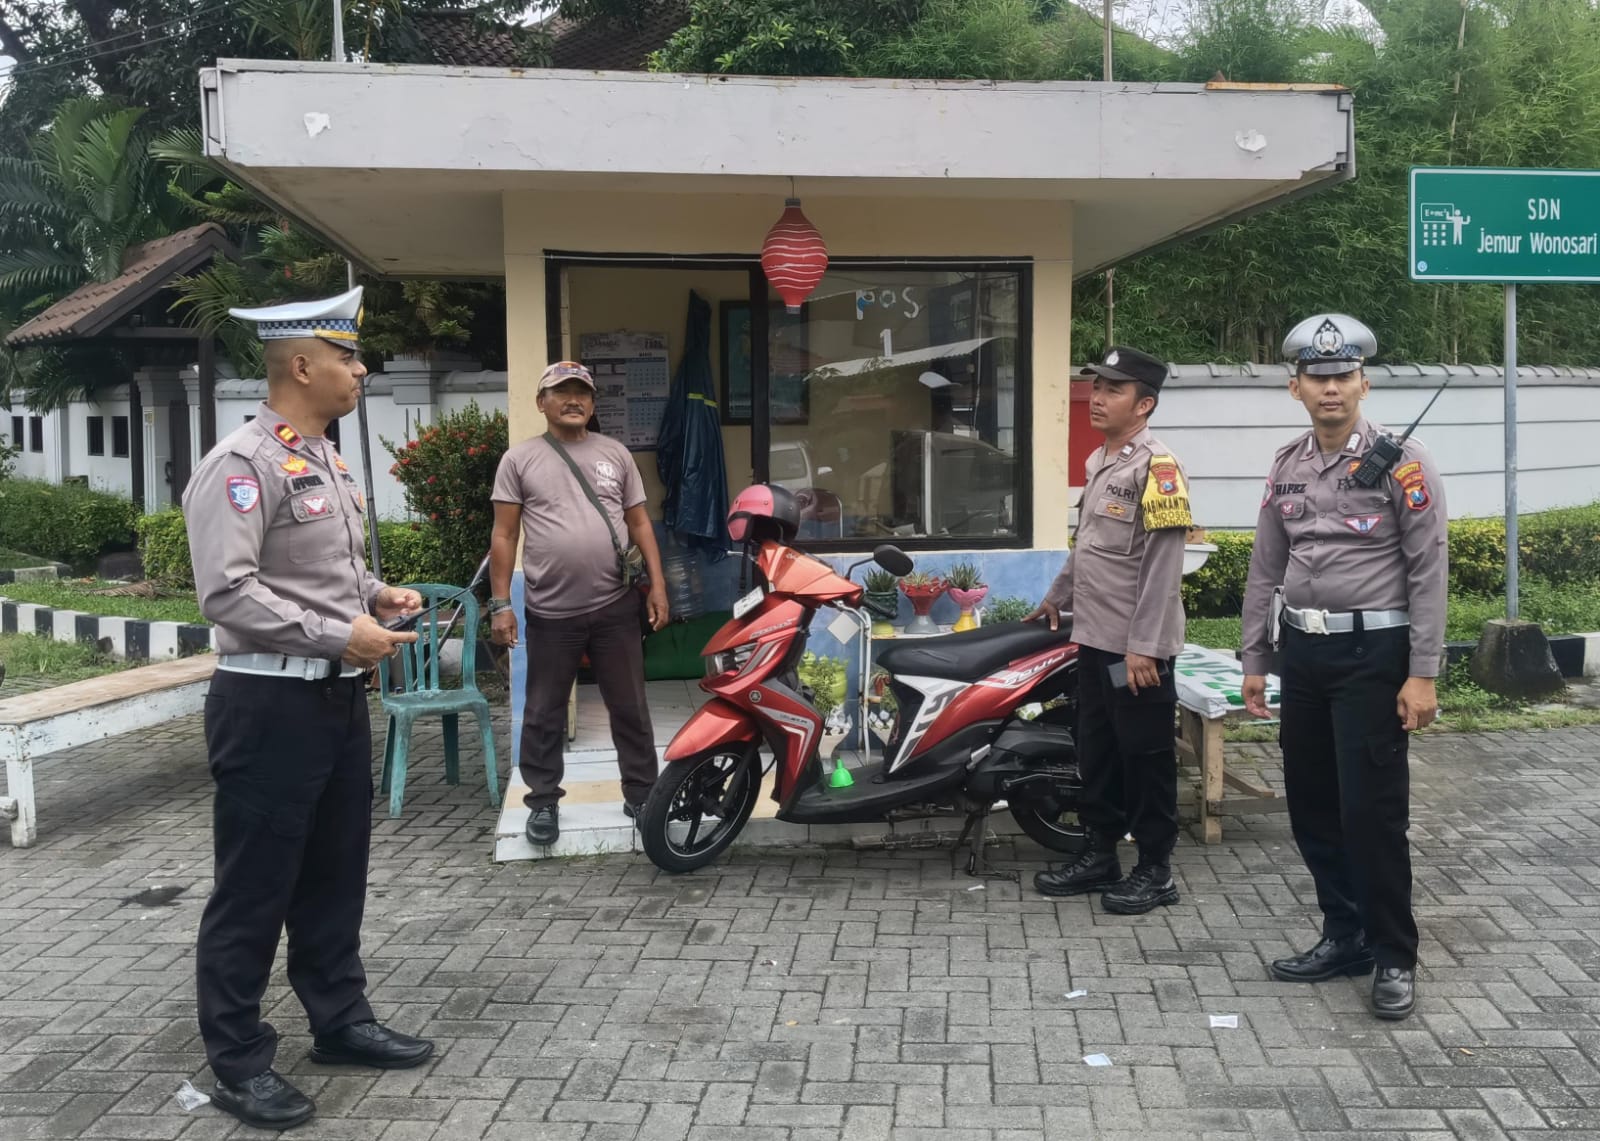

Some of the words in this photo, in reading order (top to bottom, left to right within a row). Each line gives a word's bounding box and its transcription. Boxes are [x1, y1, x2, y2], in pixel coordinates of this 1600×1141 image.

[1528, 199, 1561, 221] SDN
[1530, 232, 1598, 255] Wonosari
[1105, 484, 1137, 500] POLRI
